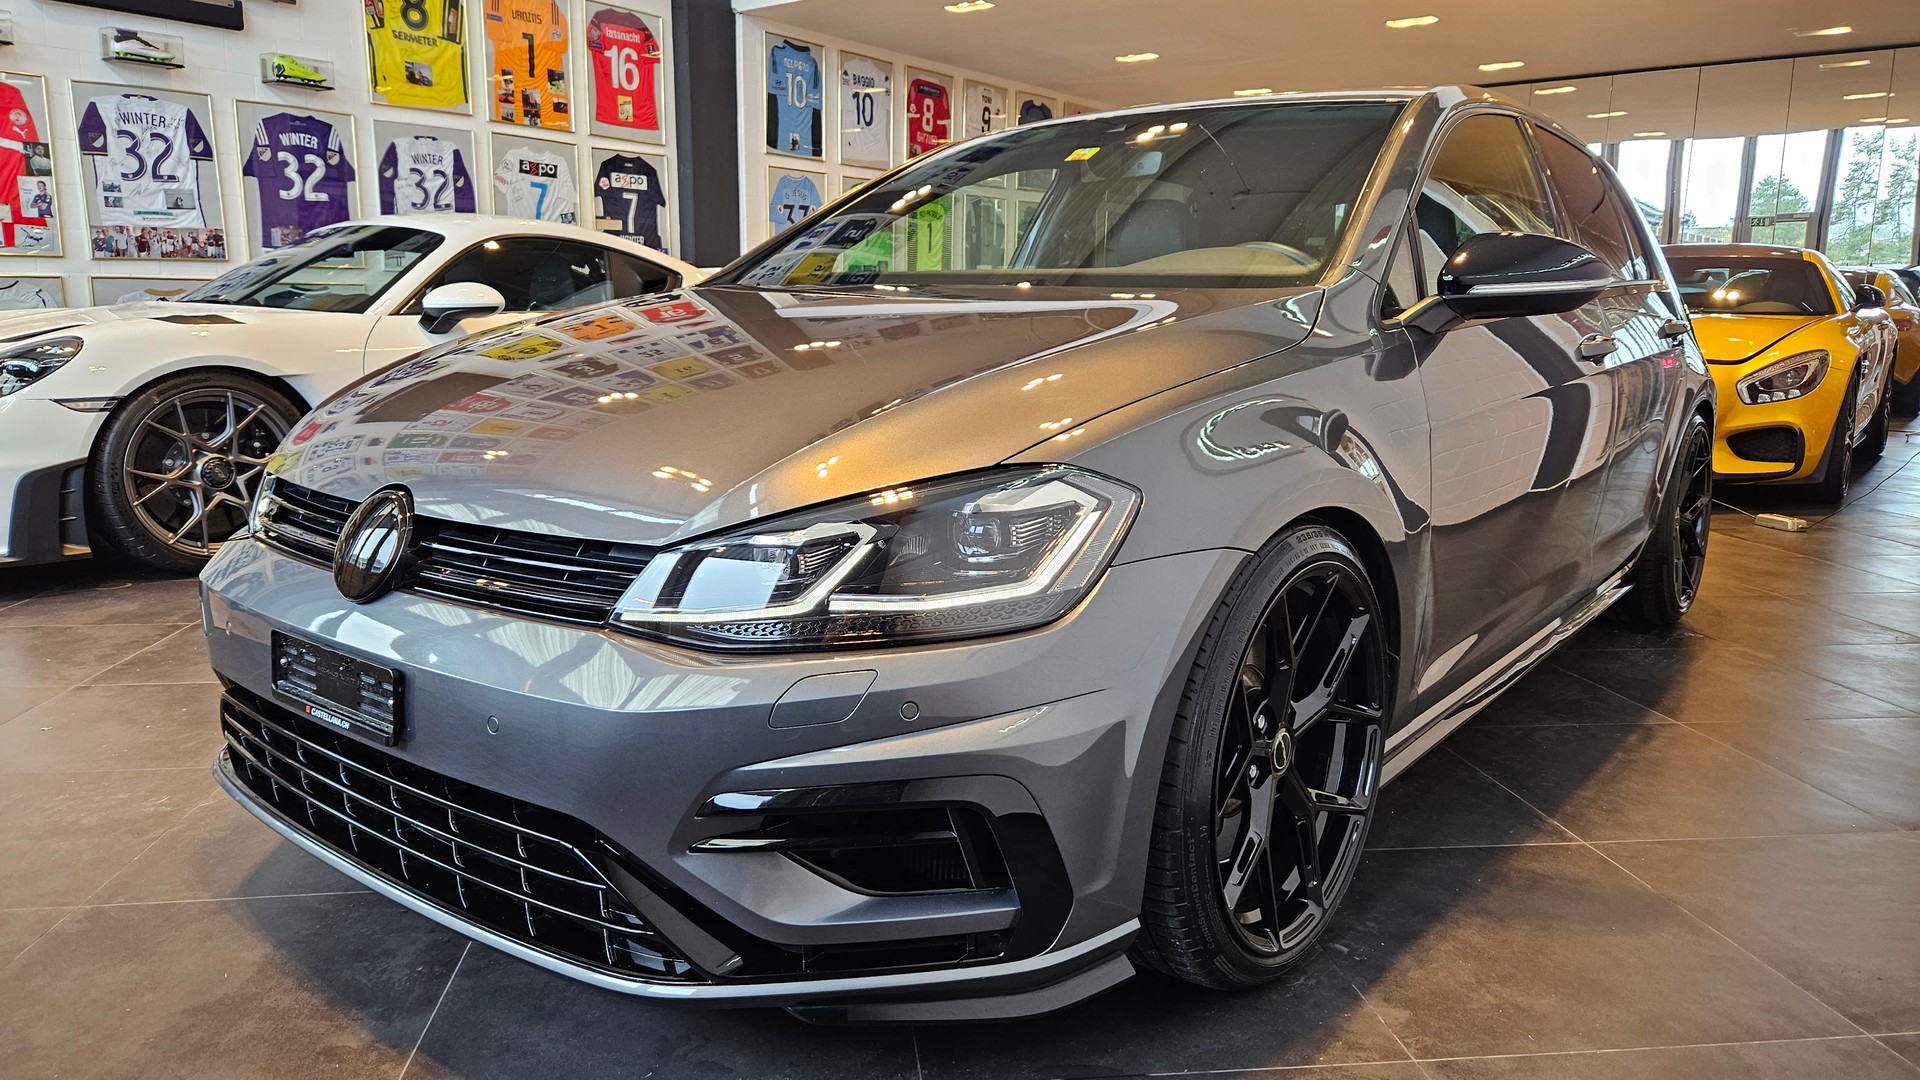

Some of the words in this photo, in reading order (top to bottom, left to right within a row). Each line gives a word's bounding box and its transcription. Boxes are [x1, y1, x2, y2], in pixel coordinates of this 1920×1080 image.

[392, 30, 438, 47] SERMETER
[522, 32, 535, 78] 1
[604, 44, 640, 91] 16
[852, 73, 875, 88] BAGGIO
[786, 72, 806, 109] 10
[119, 112, 166, 128] WINTER
[852, 91, 874, 127] 10
[922, 98, 934, 132] 8
[982, 106, 991, 132] 9
[117, 129, 179, 182] 32
[279, 133, 318, 149] WINTER
[411, 153, 443, 165] WINTER
[277, 151, 330, 201] 32
[409, 167, 453, 211] 32
[530, 181, 548, 220] 7
[622, 192, 638, 234] 7
[311, 708, 350, 730] CASTELLANA.CH
